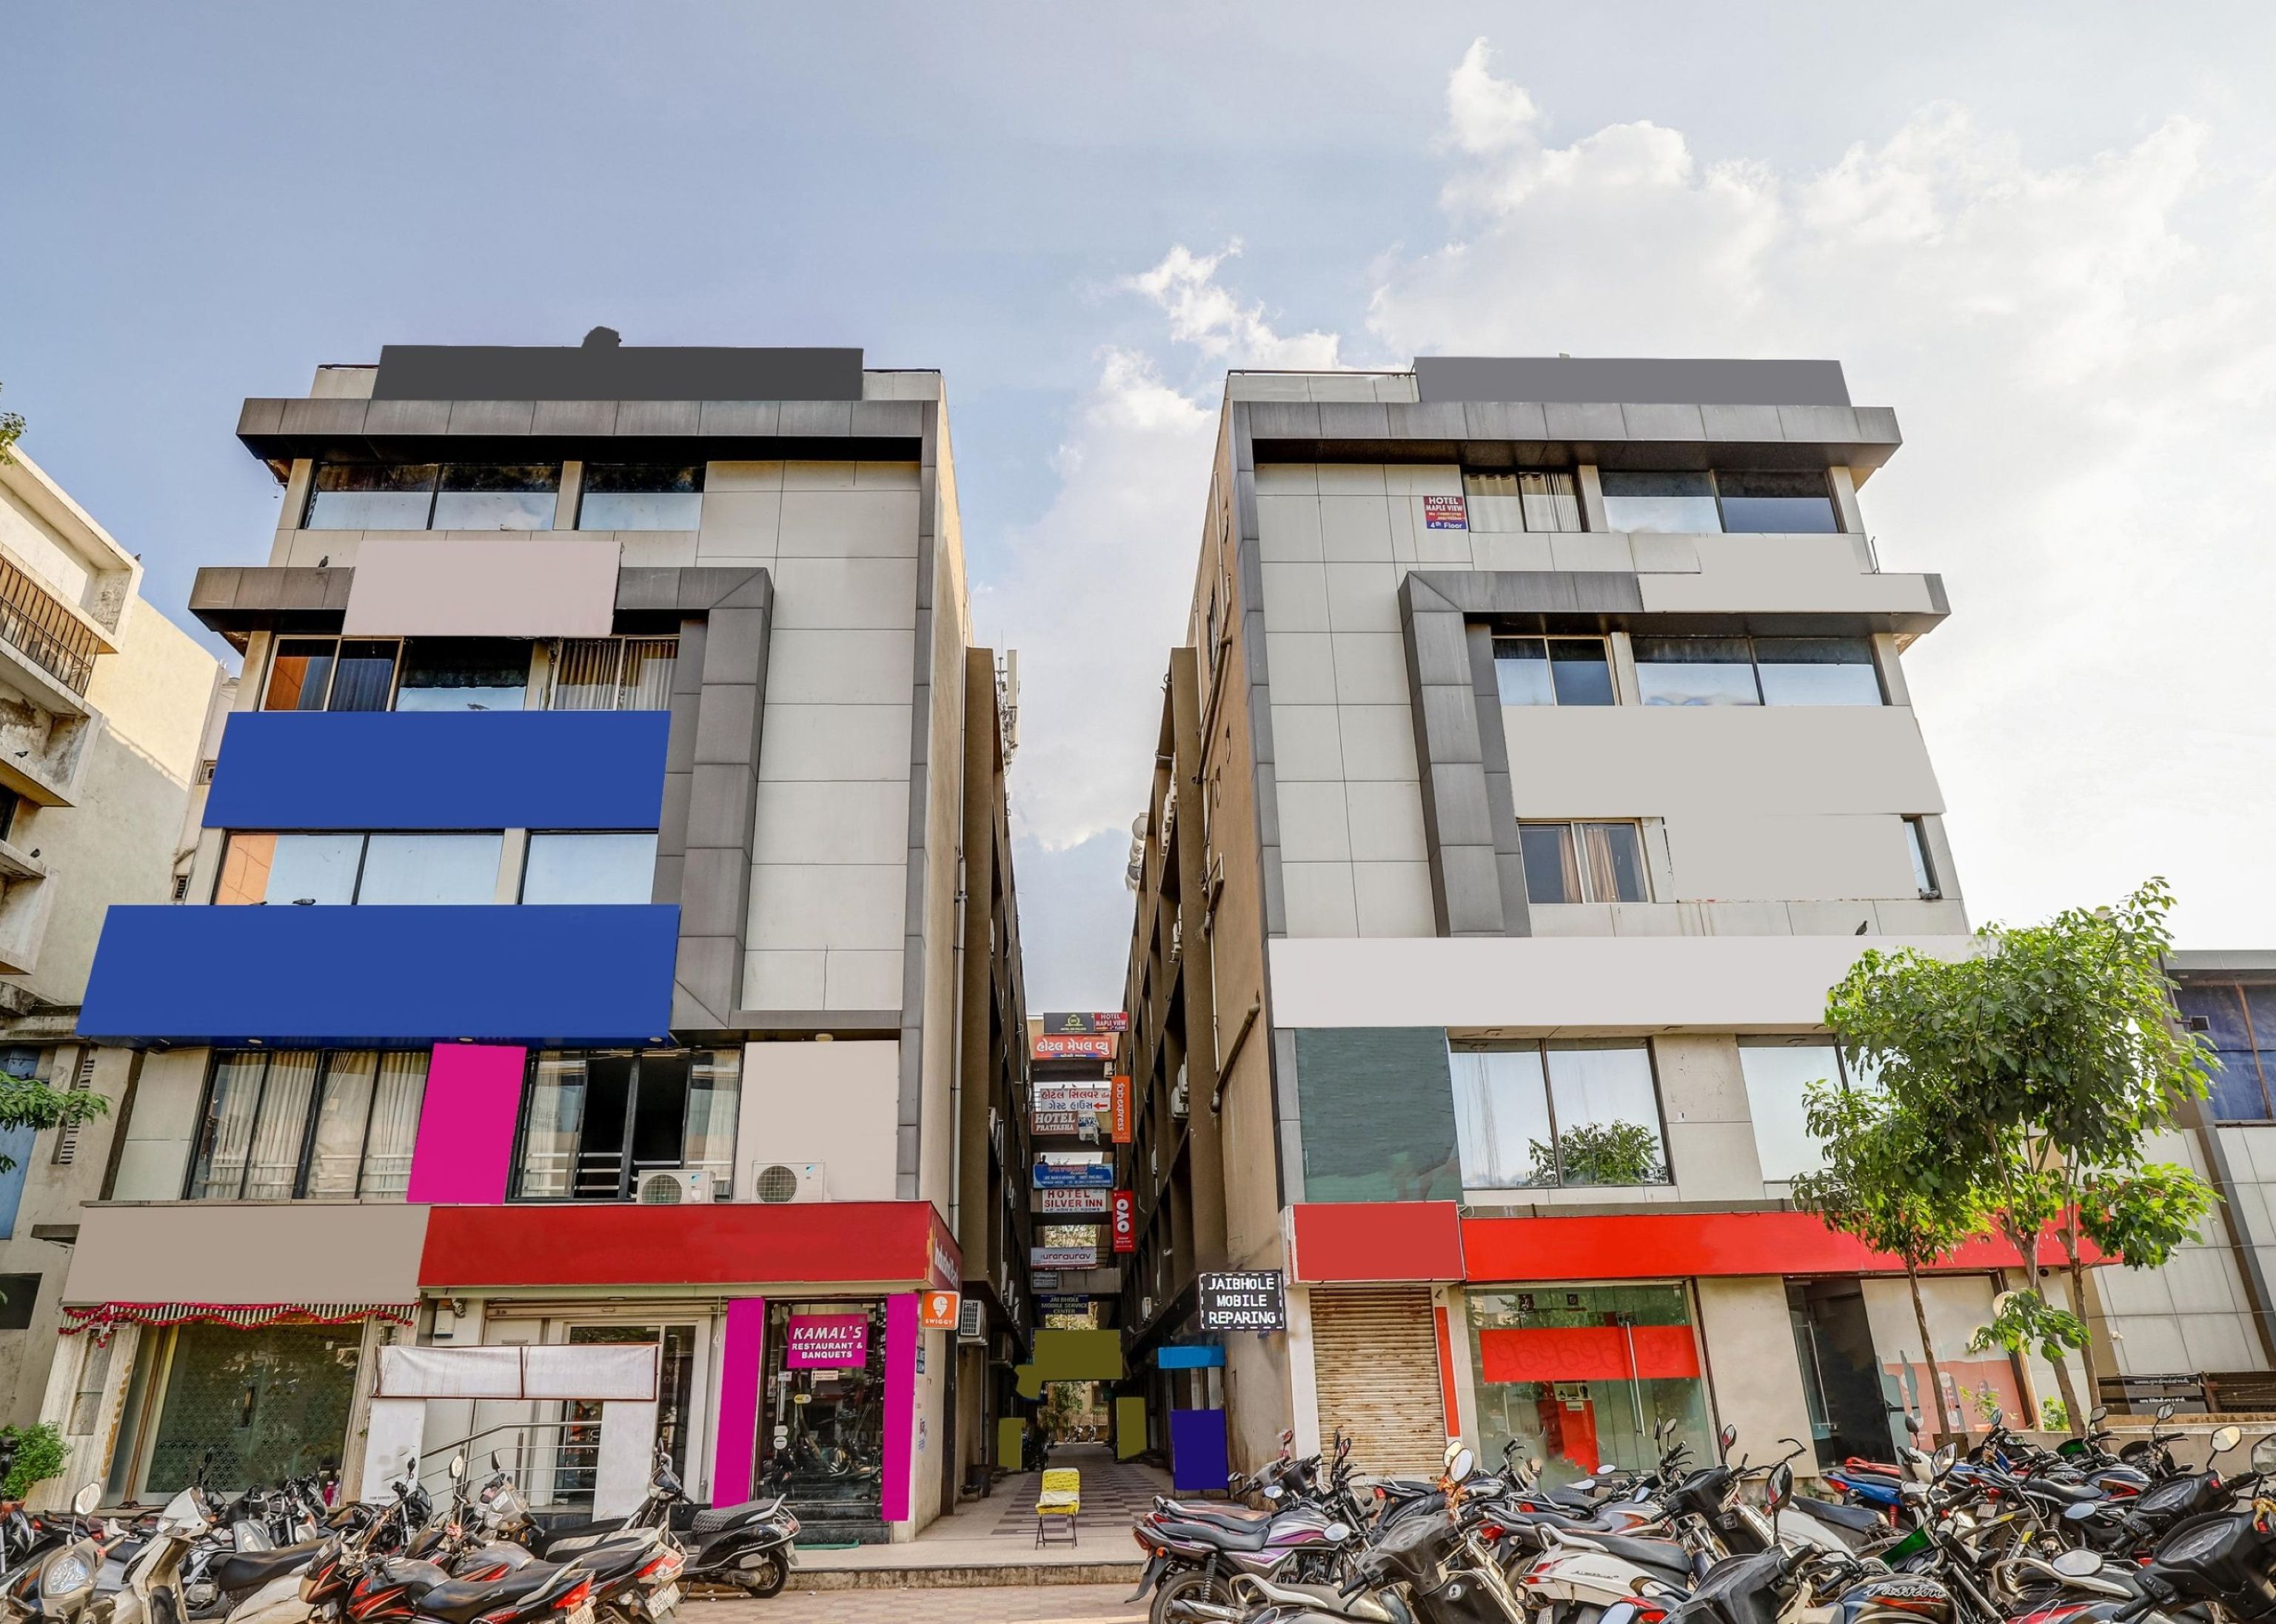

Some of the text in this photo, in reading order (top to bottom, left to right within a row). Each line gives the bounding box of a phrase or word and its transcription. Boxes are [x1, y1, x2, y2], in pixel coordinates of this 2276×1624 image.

[1037, 1038, 1063, 1051] હોટલ
[1067, 1038, 1091, 1051] મેપલ
[1041, 1088, 1063, 1099] હોટલ
[1035, 1113, 1075, 1123] HOTEL
[1048, 1190, 1090, 1198] HOTEL
[1045, 1199, 1102, 1207] SILVER INN
[1117, 1198, 1130, 1233] OYO
[1208, 1278, 1275, 1290] JAIBHOLE
[1217, 1295, 1267, 1307] MOBILE
[1208, 1312, 1276, 1323] REPARING
[793, 1325, 863, 1340] KAMAL'S
[1863, 1583, 1947, 1599] Passion
